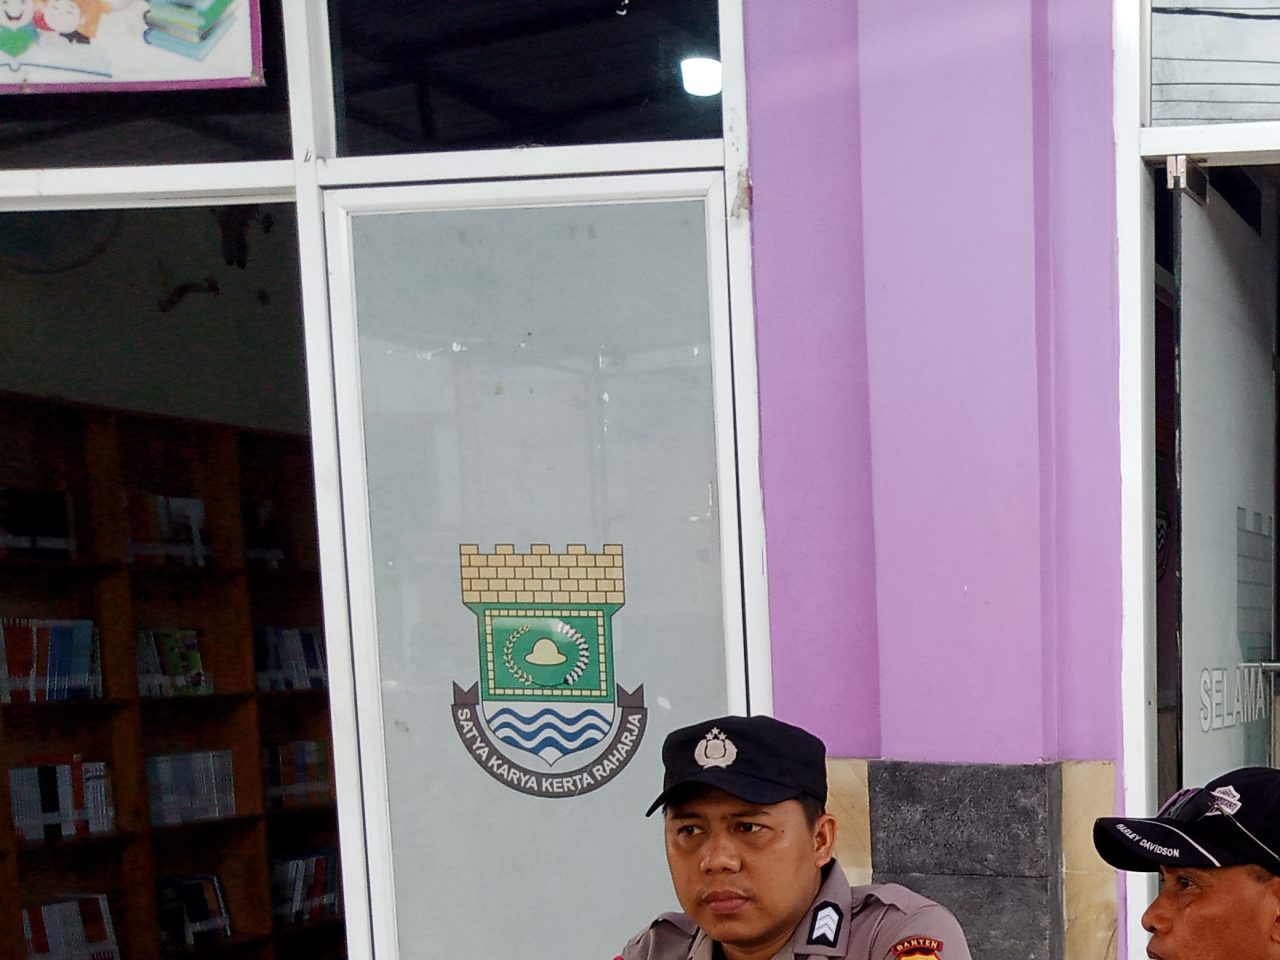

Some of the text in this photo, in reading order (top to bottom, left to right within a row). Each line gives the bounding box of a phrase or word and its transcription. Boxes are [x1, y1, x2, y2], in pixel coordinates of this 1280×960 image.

[457, 708, 642, 793] SATYA KARYA KERTA RAHARJA
[1115, 823, 1181, 858] HARLEY DAVIDSON
[895, 938, 939, 952] BANTEN
